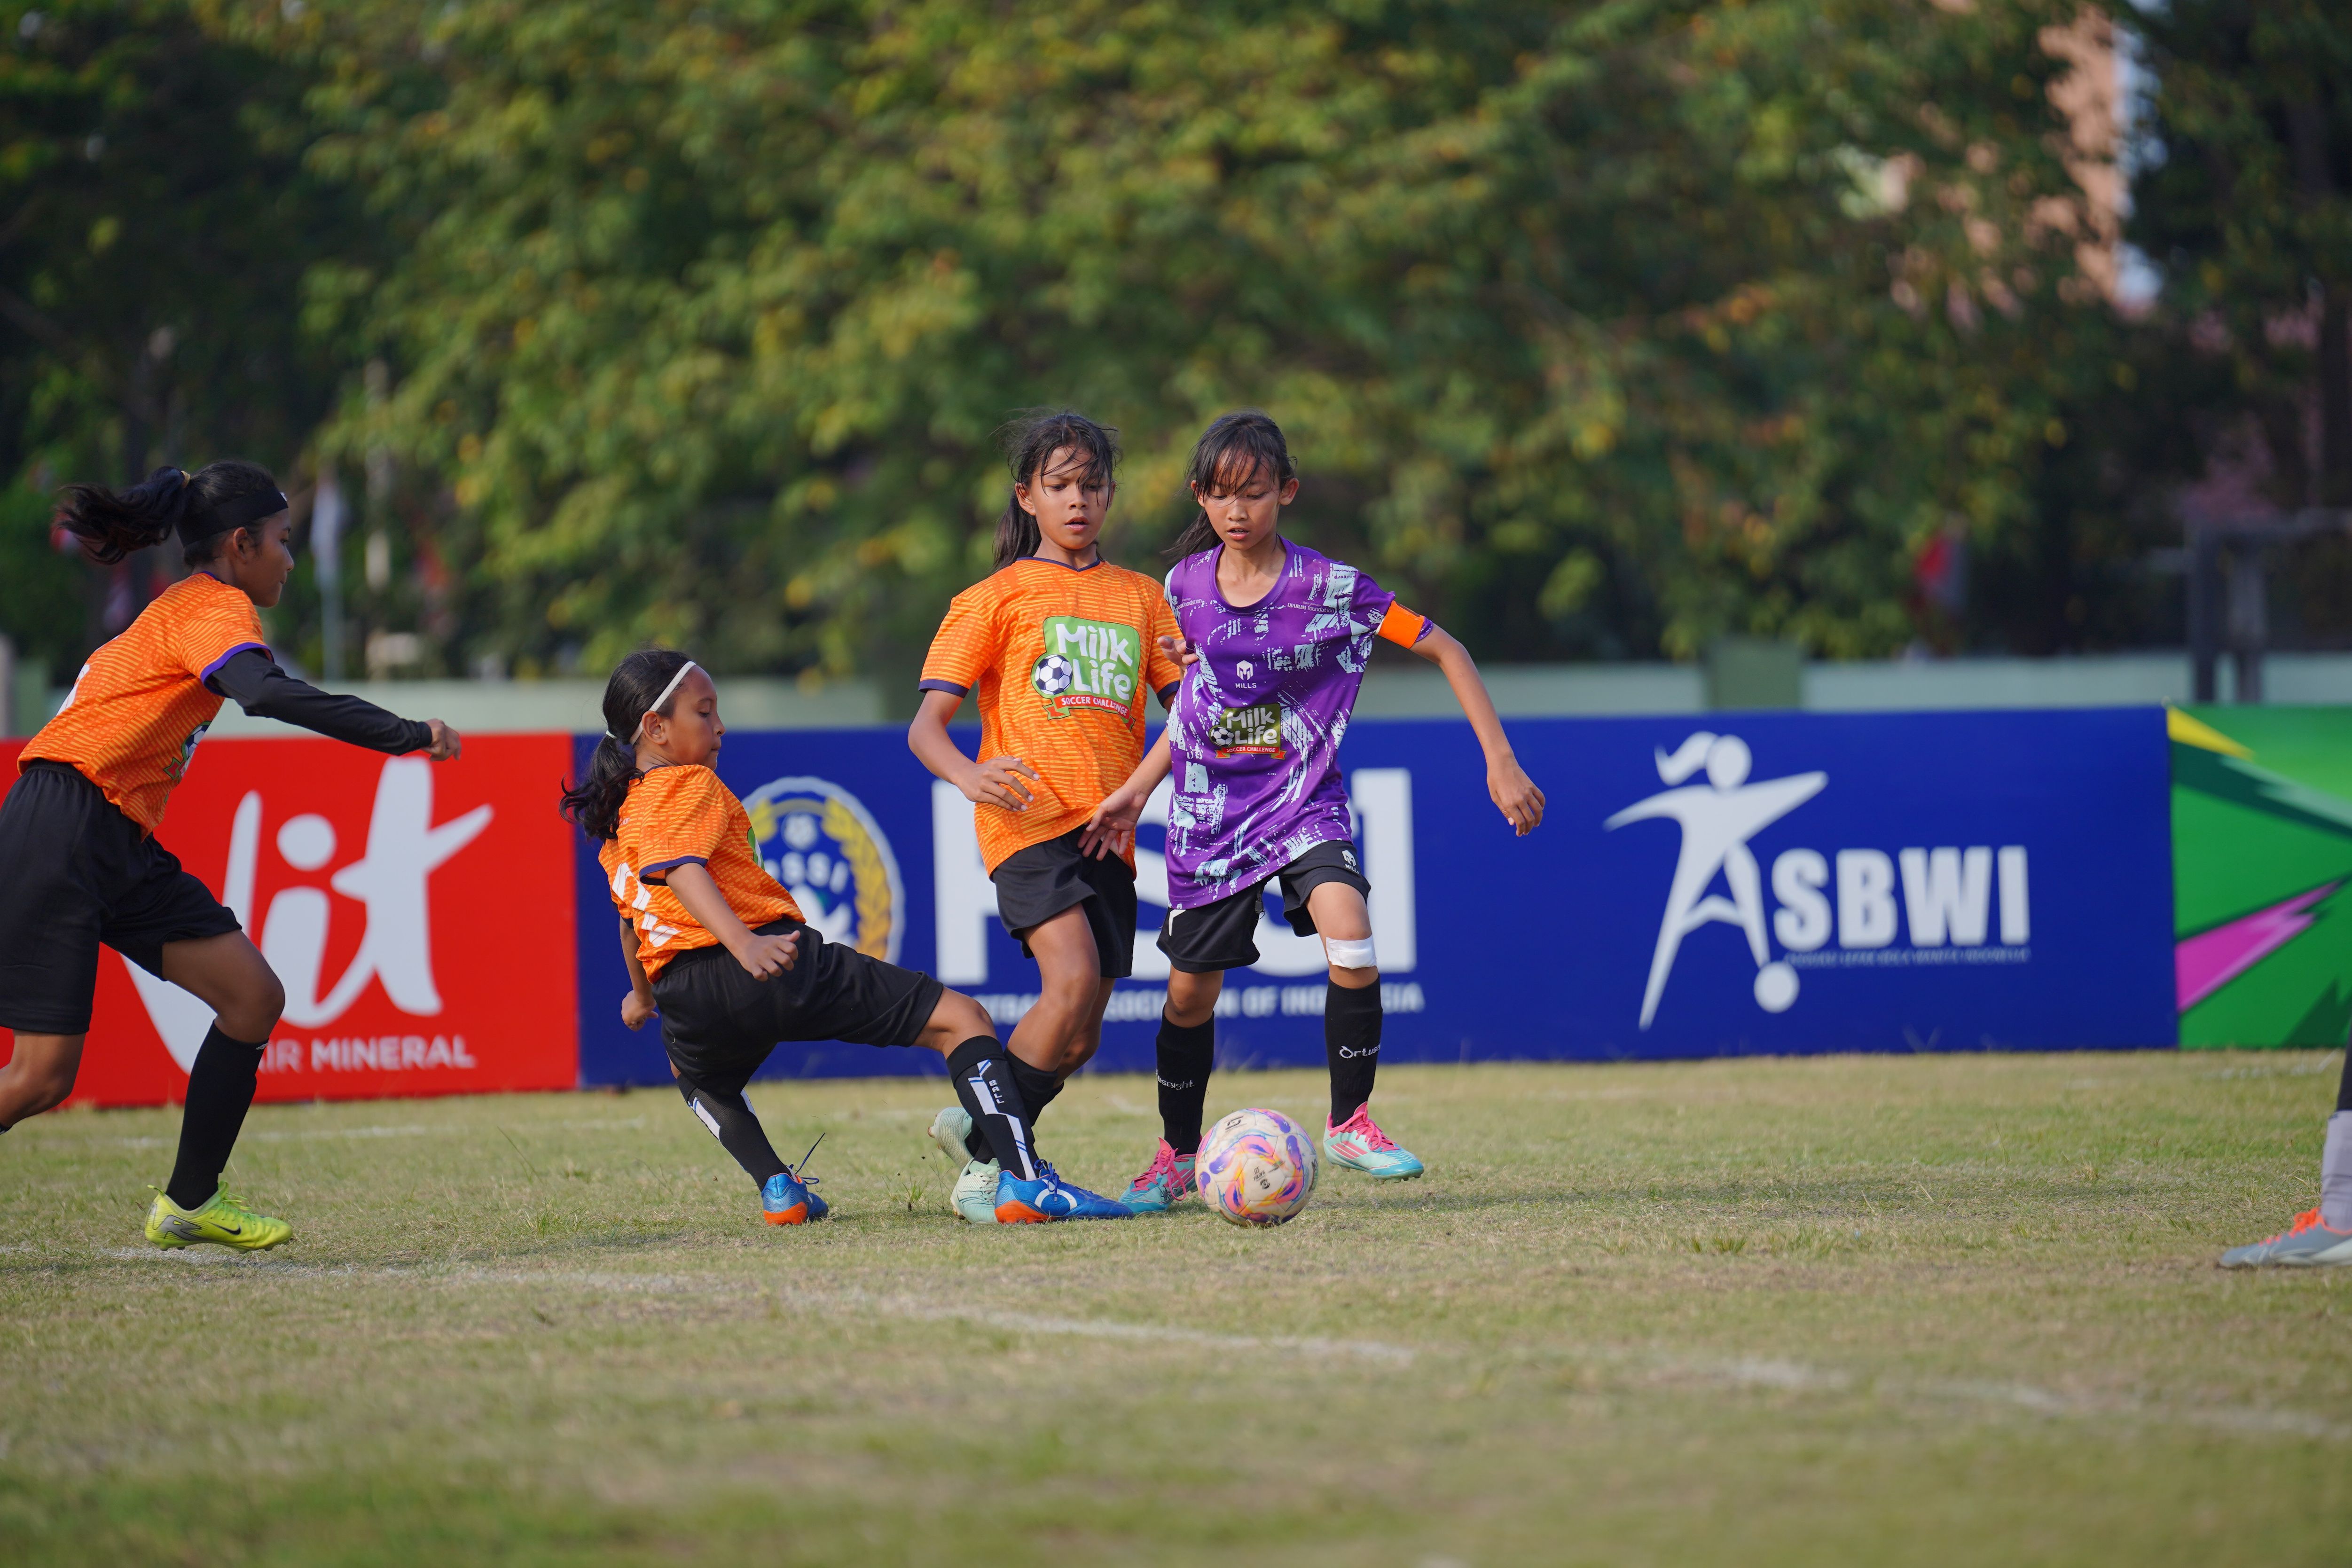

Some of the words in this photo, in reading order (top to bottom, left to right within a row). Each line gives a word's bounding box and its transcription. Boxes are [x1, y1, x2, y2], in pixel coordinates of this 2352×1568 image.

[1307, 605, 1335, 613] foundation
[1056, 623, 1133, 666] Milk
[1073, 659, 1131, 700] Life
[1061, 696, 1091, 706] SOCCER
[1093, 698, 1128, 716] CHALLENGE
[1227, 707, 1275, 729] Milk
[1235, 726, 1277, 745] Life
[311, 1034, 477, 1073] MINERAL
[988, 1079, 1005, 1104] BALL
